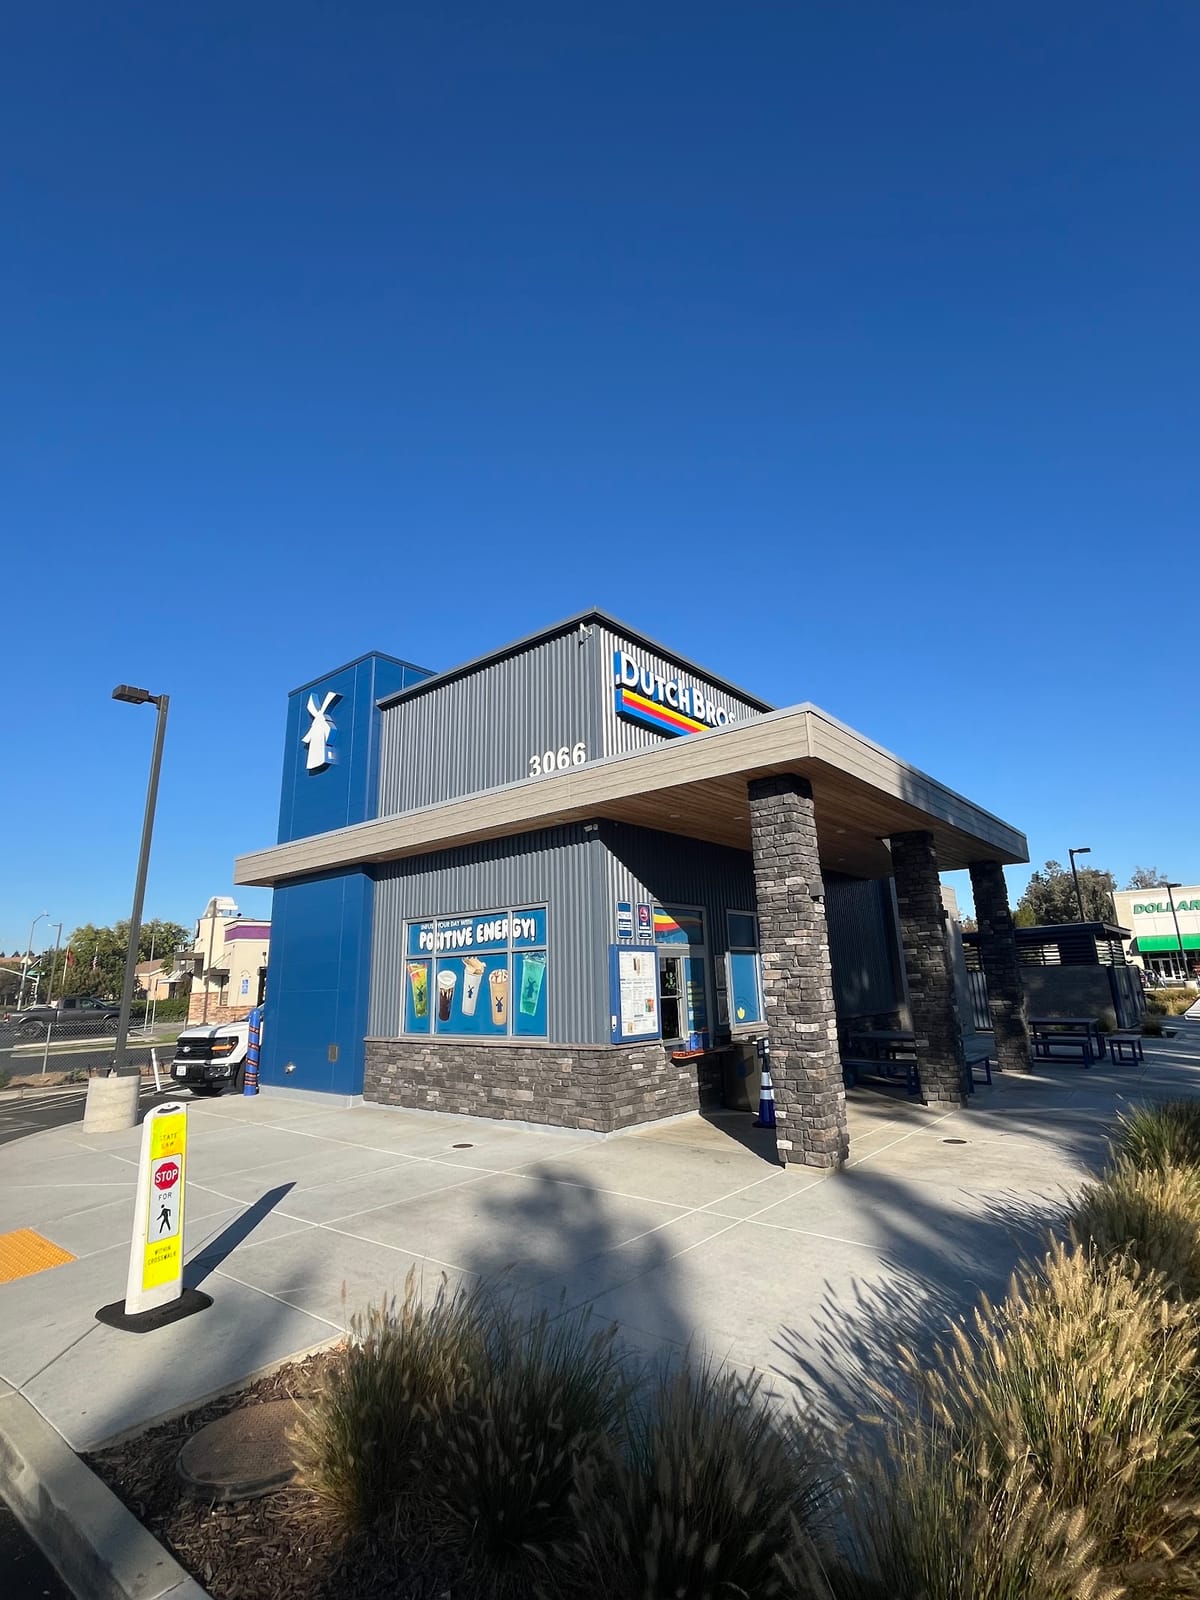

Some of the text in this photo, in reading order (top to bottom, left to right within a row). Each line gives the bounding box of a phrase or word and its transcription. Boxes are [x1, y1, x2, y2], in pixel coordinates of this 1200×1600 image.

[615, 650, 691, 714] DUTCH
[529, 742, 586, 777] 3066
[1133, 900, 1200, 915] DOLLAR
[476, 917, 536, 943] ENERGY!
[155, 1168, 178, 1184] STOP
[158, 1191, 173, 1201] FOR
